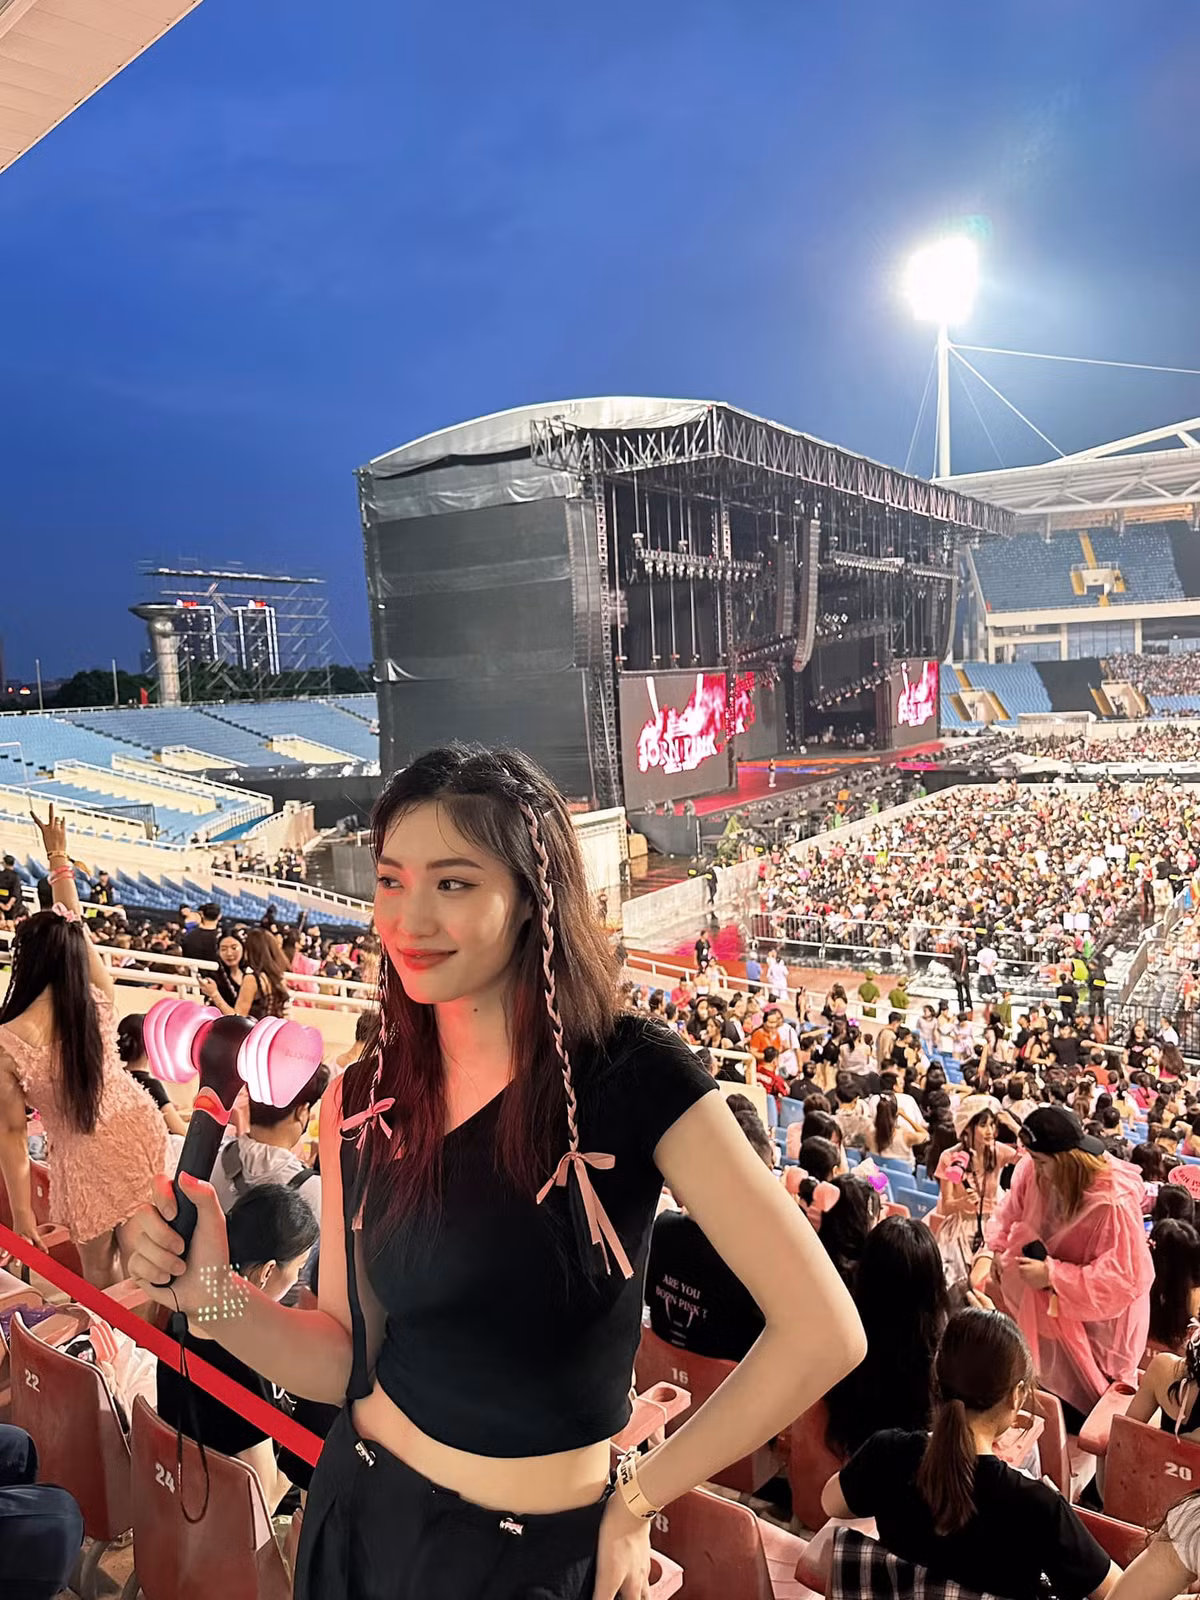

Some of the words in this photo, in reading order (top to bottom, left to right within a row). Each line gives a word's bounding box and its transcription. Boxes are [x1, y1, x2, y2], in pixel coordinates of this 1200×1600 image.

[662, 1273, 680, 1290] ARE
[681, 1282, 701, 1300] YOU
[24, 1368, 41, 1393] 22
[671, 1367, 689, 1385] 16
[155, 1462, 176, 1495] 24
[1164, 1461, 1193, 1482] 20
